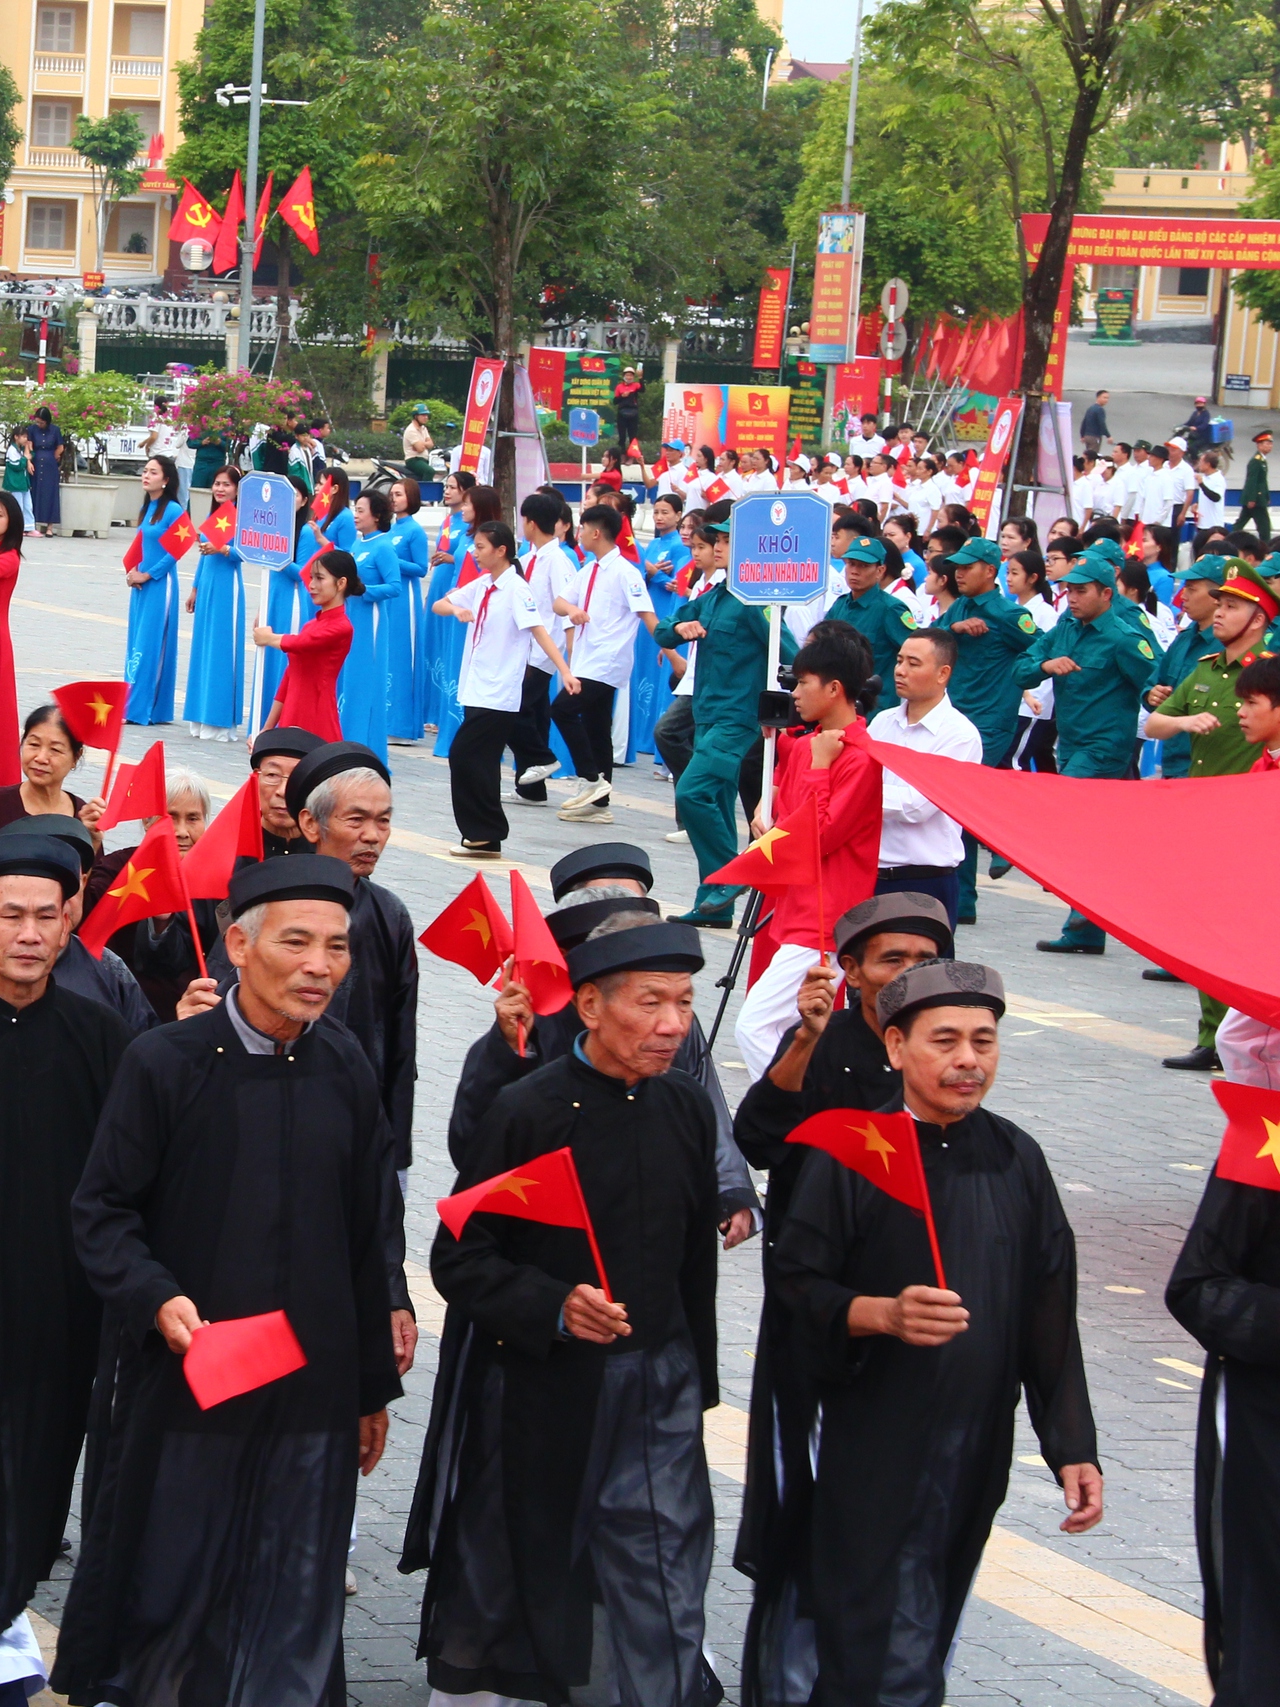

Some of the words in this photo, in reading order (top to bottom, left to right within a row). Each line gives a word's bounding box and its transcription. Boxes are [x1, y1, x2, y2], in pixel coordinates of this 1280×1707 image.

[1072, 225, 1098, 238] MỪNG
[1115, 227, 1131, 242] HỘI
[1147, 226, 1168, 241] BIỂU
[1194, 230, 1207, 245] BỘ
[1209, 230, 1227, 243] CÁC
[1228, 229, 1246, 243] CẤP
[1247, 231, 1277, 246] NHIỆM
[1094, 241, 1114, 256] BIỂU
[1115, 245, 1138, 257] TOÀN
[1139, 244, 1163, 259] QUỐC
[1163, 245, 1182, 259] LẦN
[1183, 246, 1200, 260] THỨ
[1200, 249, 1216, 260] XIV
[1216, 246, 1234, 260] CỦA
[120, 437, 137, 454] TRẬT
[253, 505, 278, 526] KHỐI
[241, 526, 260, 549] DÂN
[262, 531, 288, 554] QUÂN
[758, 526, 799, 554] KHỐI
[739, 558, 761, 583] CÔNG
[762, 562, 774, 583] AN
[774, 558, 798, 583] NHÂN
[799, 558, 819, 583] DÂN
